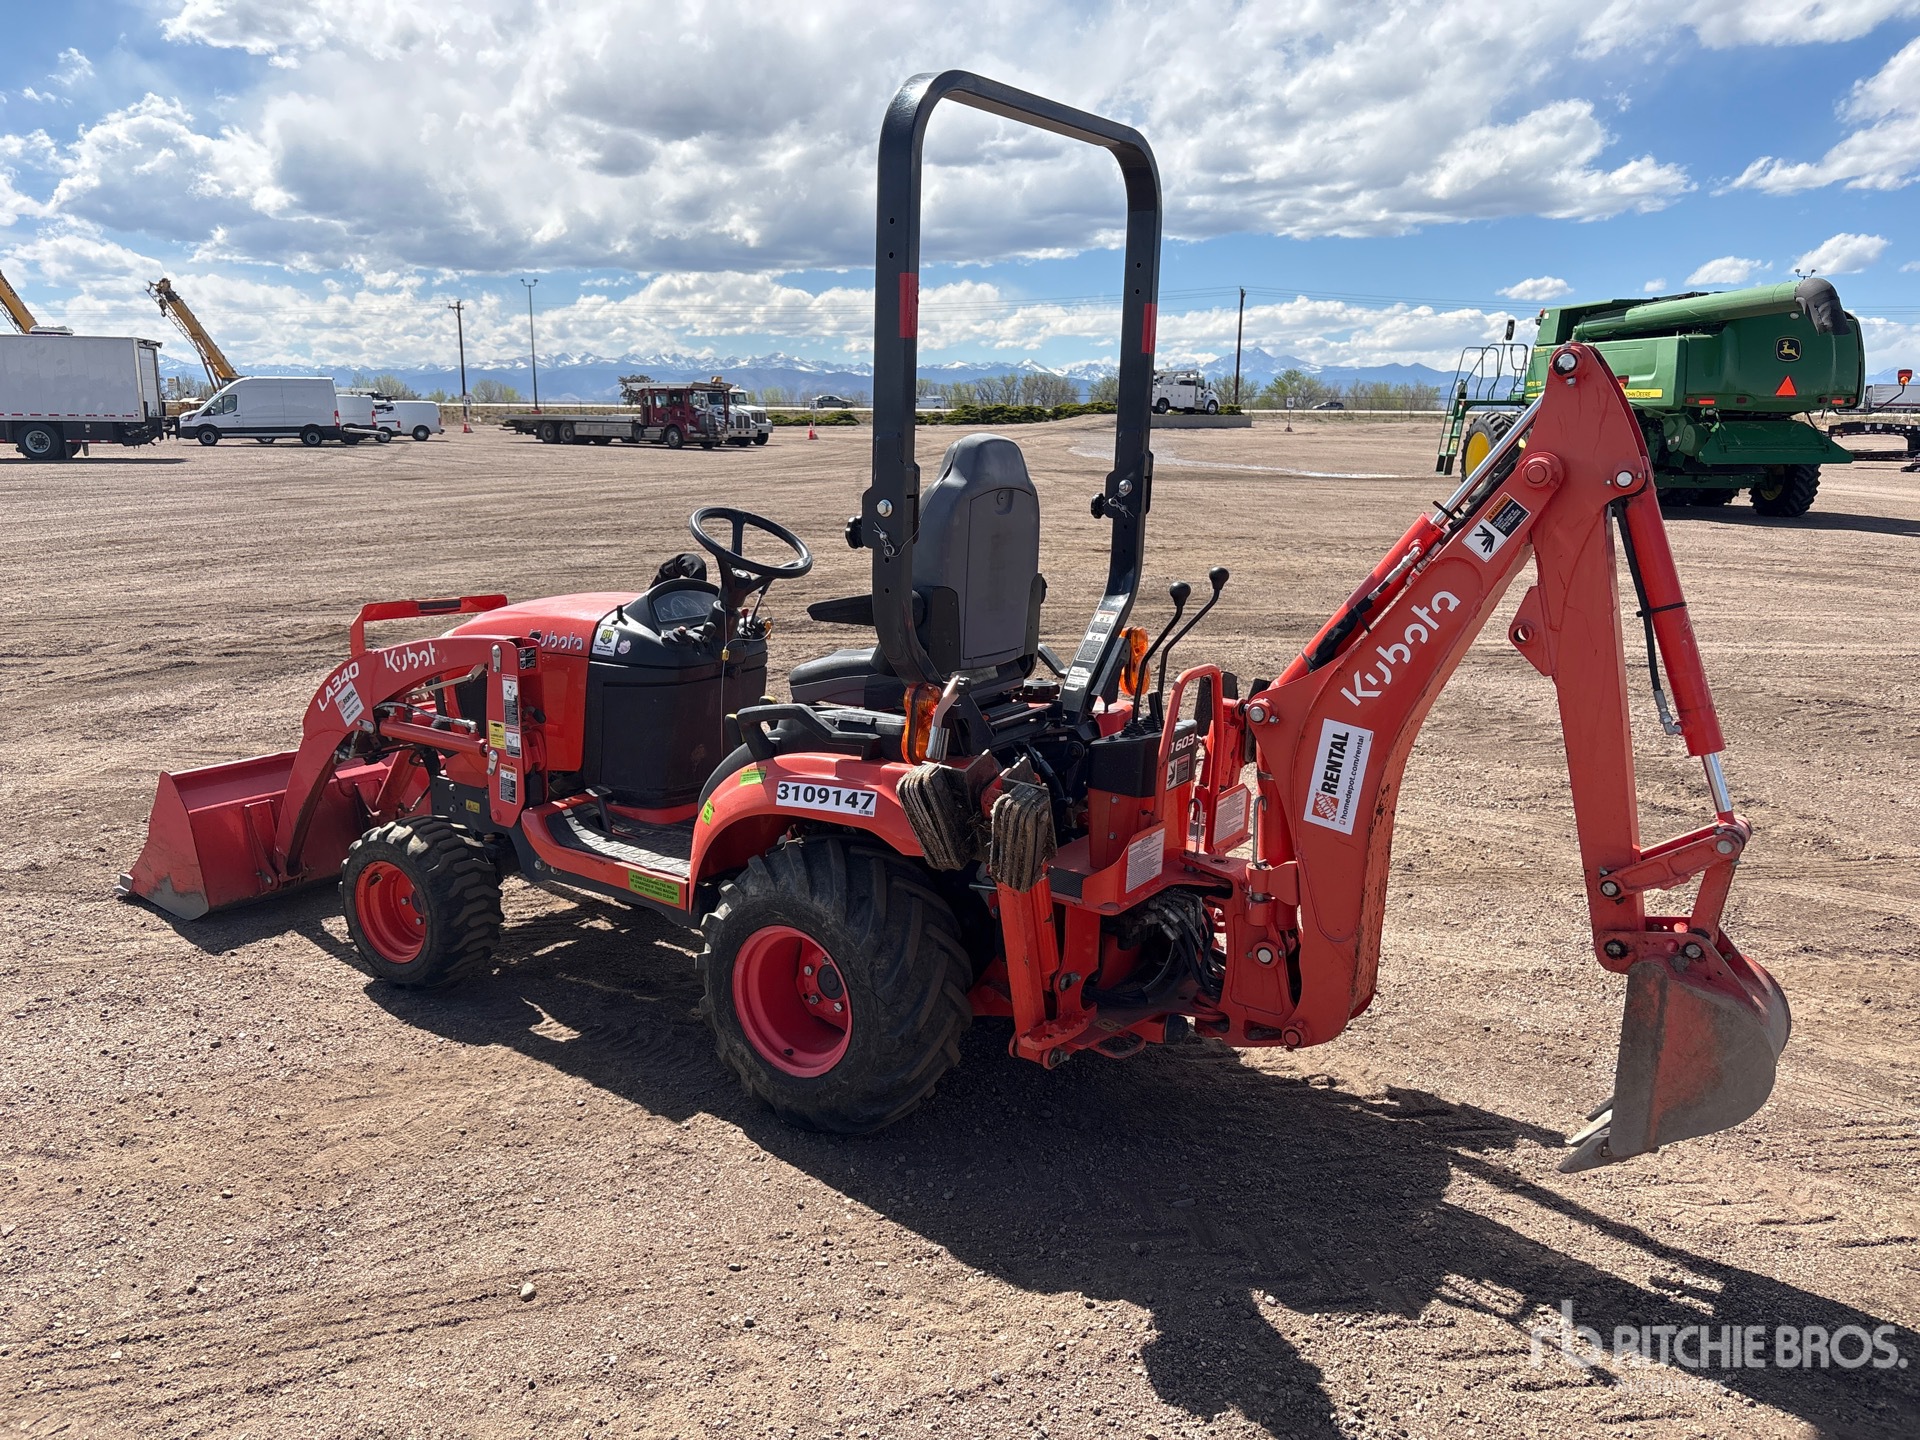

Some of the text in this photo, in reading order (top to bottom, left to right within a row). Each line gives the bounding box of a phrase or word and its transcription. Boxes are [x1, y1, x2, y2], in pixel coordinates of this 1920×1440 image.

[1340, 591, 1460, 706] Kubota
[317, 662, 359, 712] LA340
[1321, 732, 1350, 795] RENTAL
[1340, 735, 1364, 820] homedepot.com/rental
[777, 783, 875, 810] 3109147
